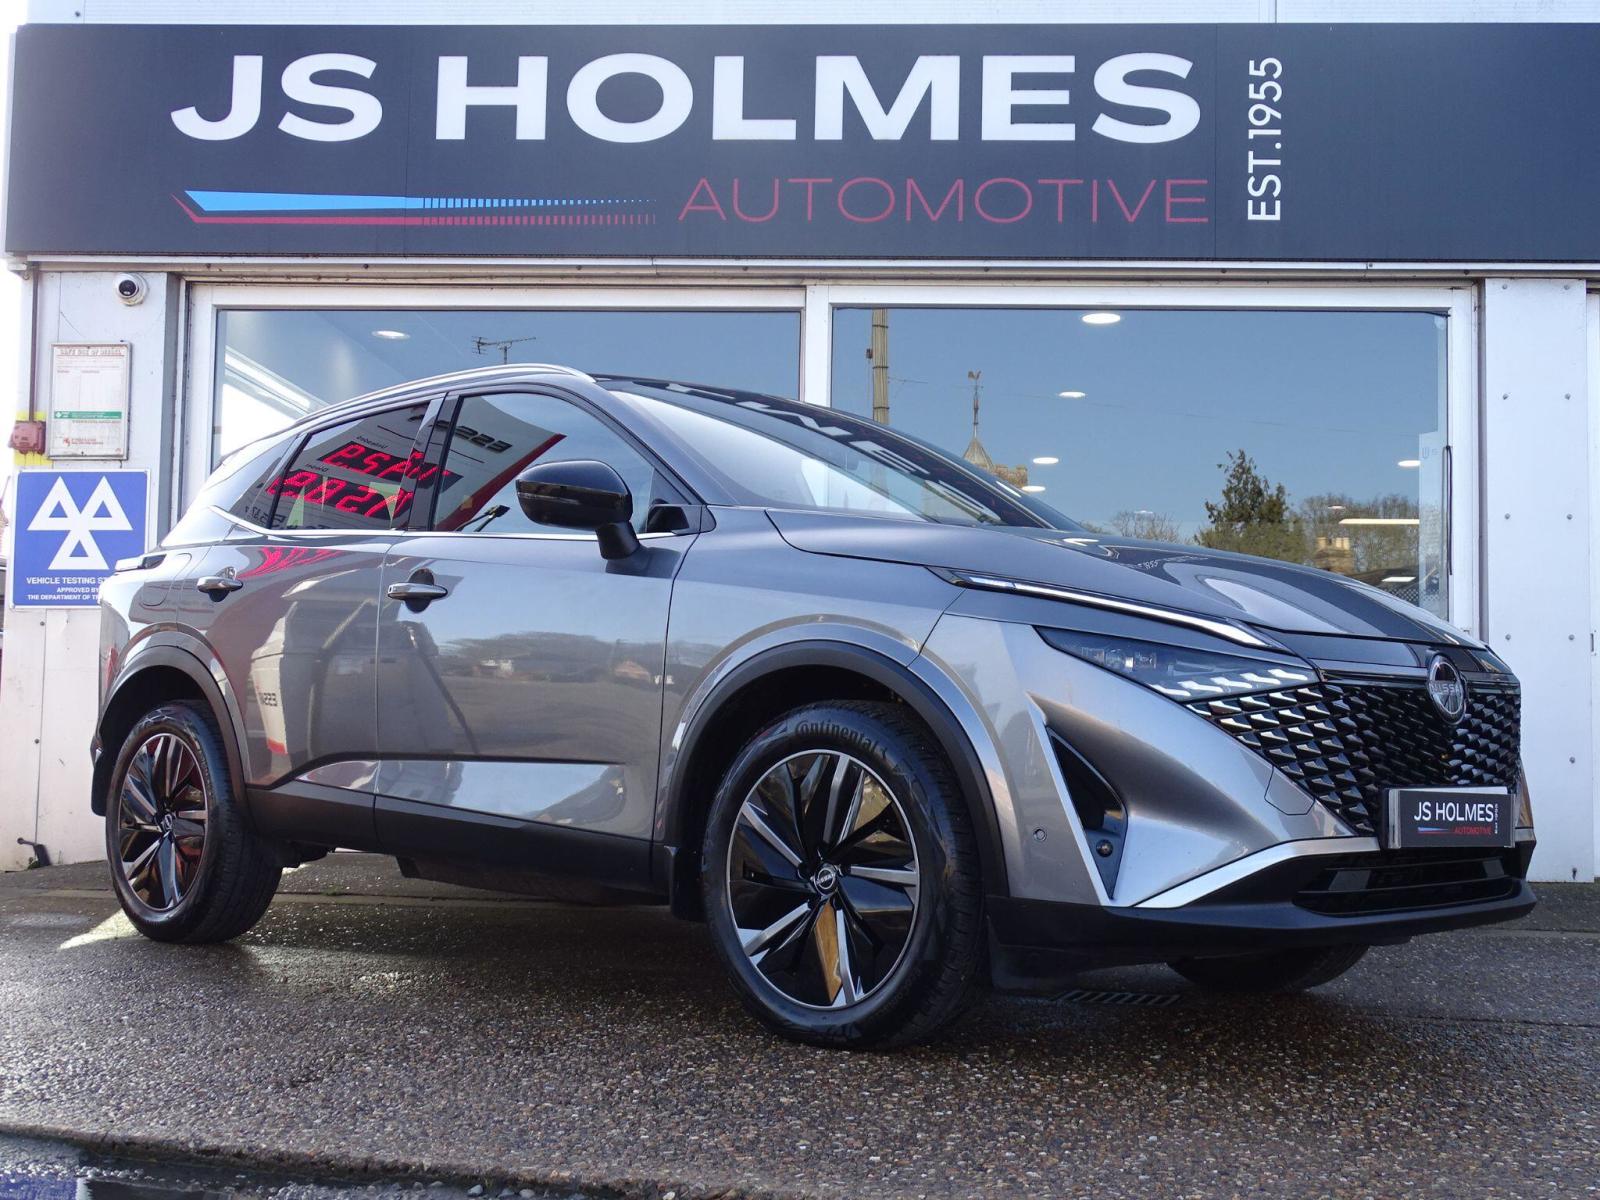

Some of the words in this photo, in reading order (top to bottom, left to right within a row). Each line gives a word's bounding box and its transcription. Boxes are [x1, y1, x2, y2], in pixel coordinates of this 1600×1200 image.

[171, 53, 382, 142] JS
[435, 52, 1201, 143] HOLMES
[1248, 56, 1282, 222] EST.1955
[678, 177, 1209, 224] AUTOMOTIVE
[796, 719, 879, 752] Continental
[1414, 802, 1432, 821] JS
[1435, 802, 1494, 822] HOLMES
